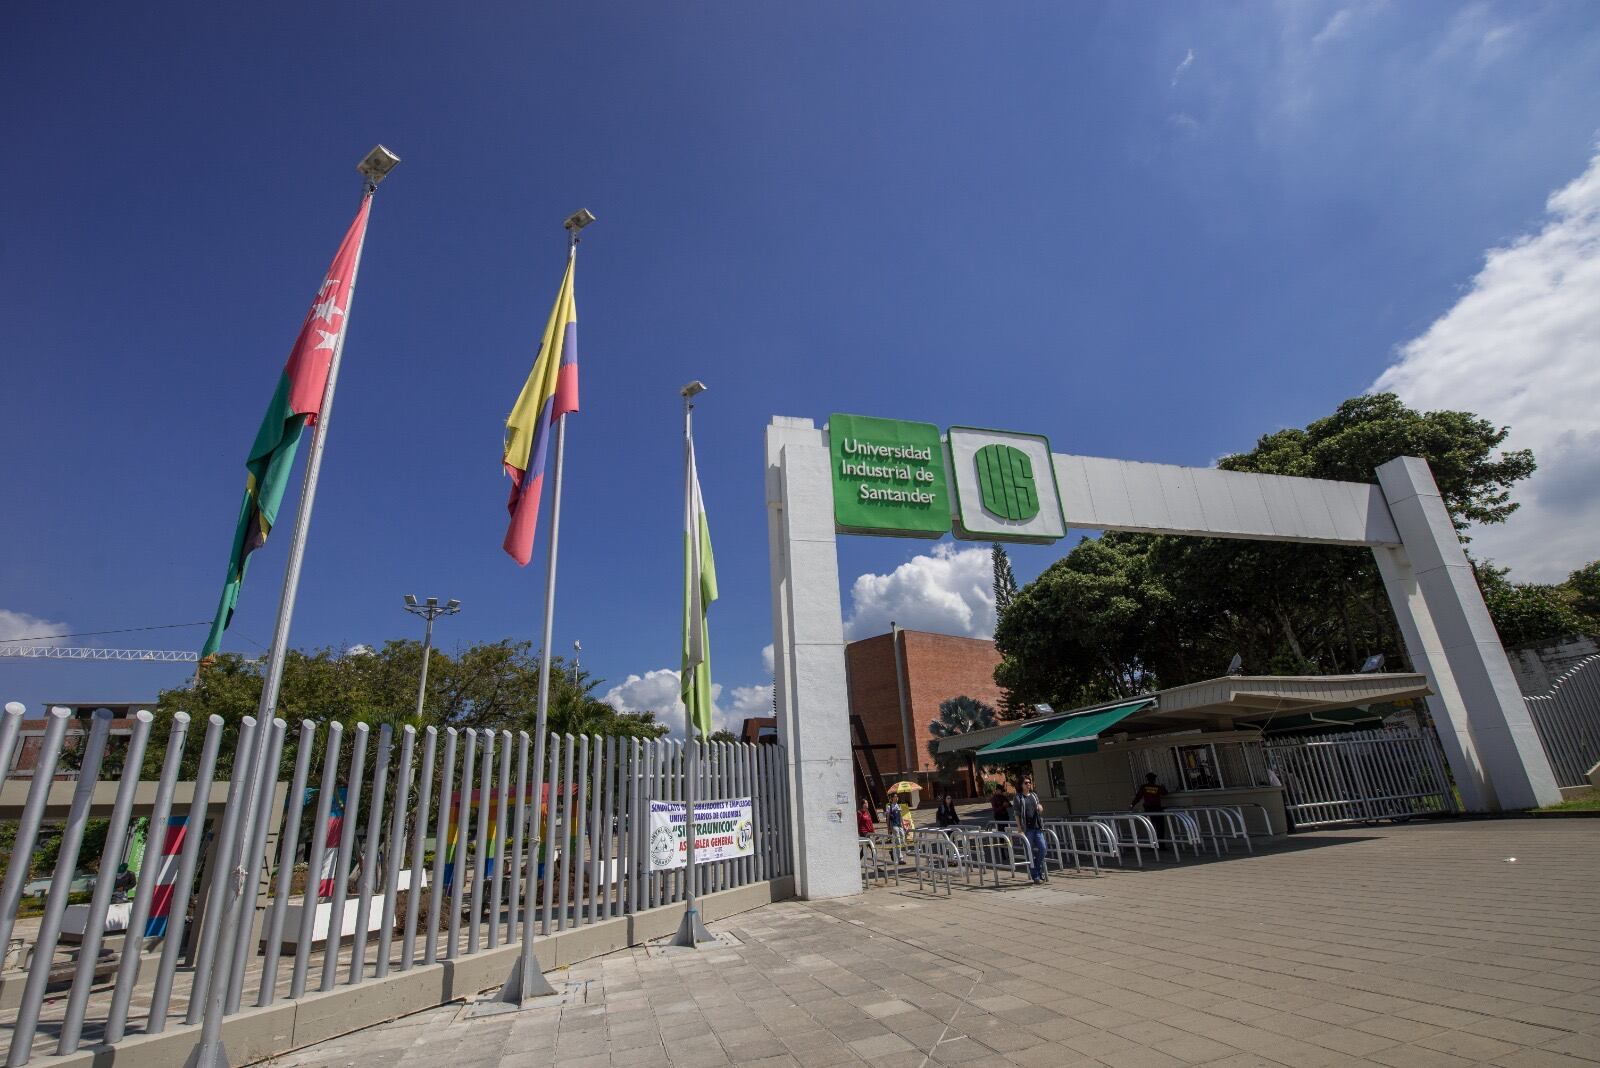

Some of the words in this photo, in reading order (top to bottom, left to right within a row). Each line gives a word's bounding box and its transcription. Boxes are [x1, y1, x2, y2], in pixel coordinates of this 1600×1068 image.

[844, 438, 931, 461] Universidad
[842, 459, 911, 480] Industrial
[915, 467, 935, 482] de
[860, 484, 936, 504] Santander
[669, 813, 713, 823] UNIVETARIOS
[672, 820, 738, 838] "SITRAUNICOL"
[679, 838, 710, 851] ASBLEA
[710, 835, 734, 847] GENERAL
